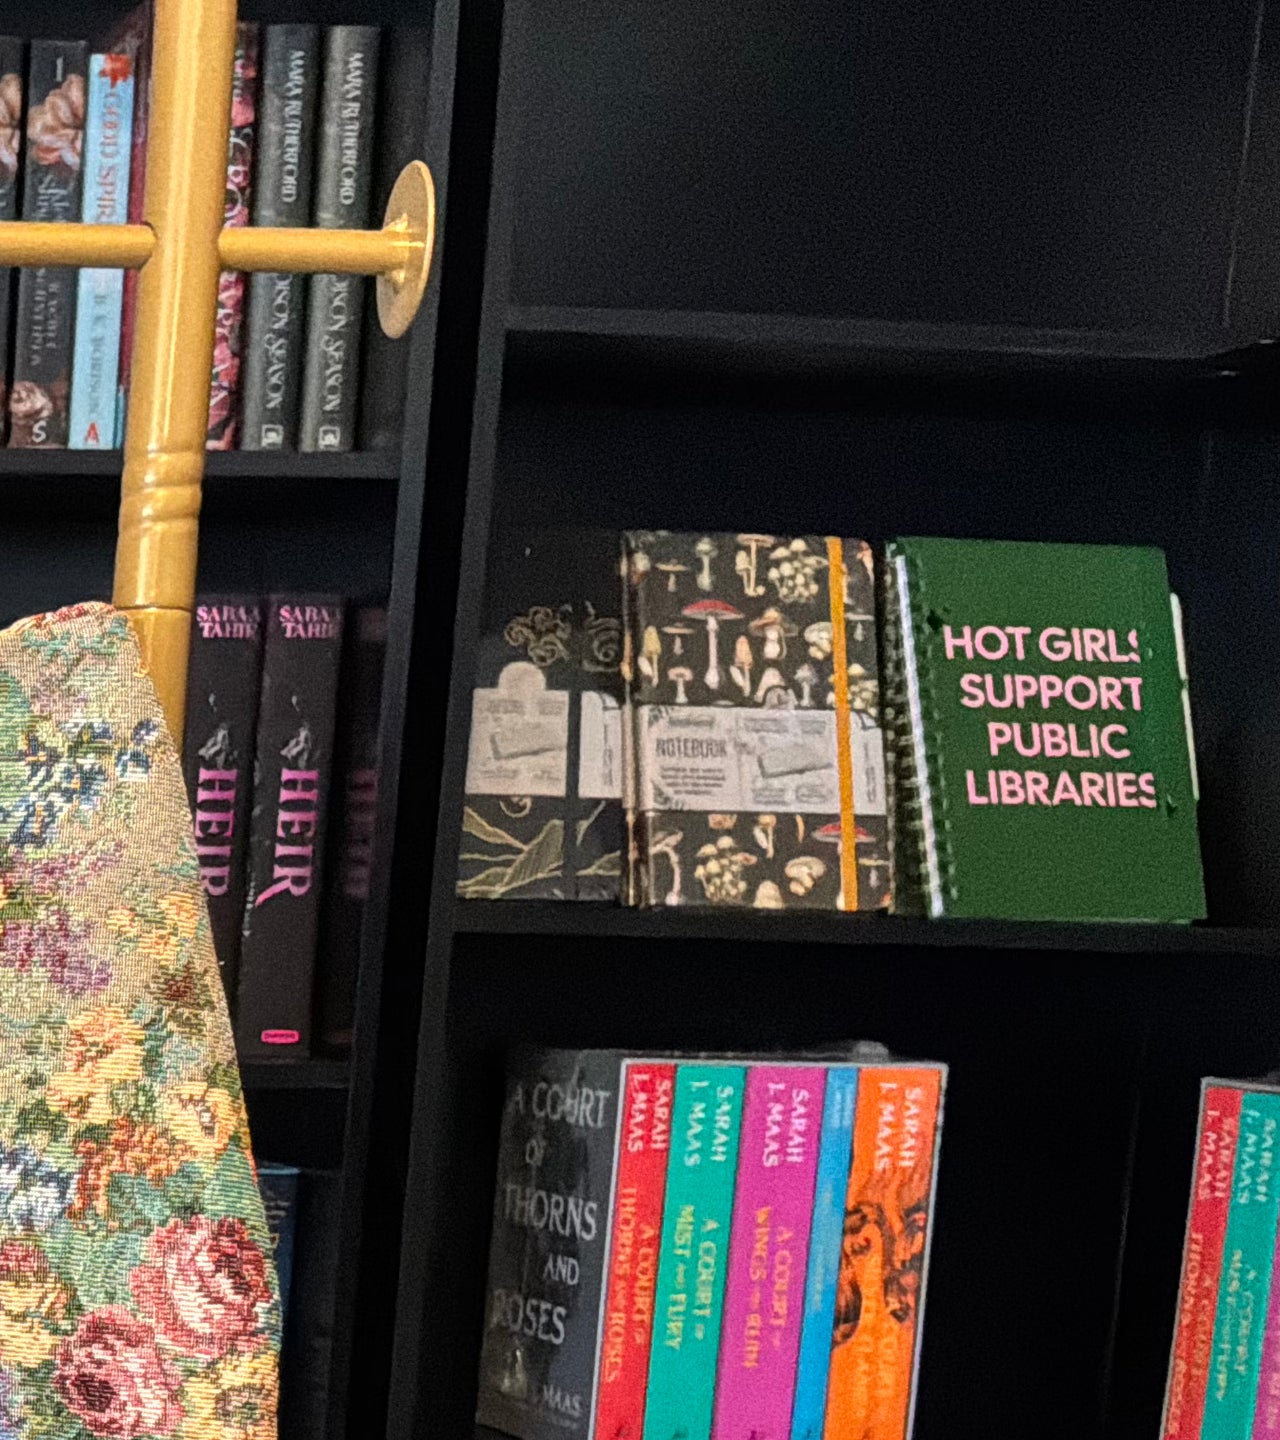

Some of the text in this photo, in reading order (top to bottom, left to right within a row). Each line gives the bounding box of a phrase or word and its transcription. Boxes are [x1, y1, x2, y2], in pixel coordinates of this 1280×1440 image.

[944, 625, 1140, 663] HOT GIRLS
[959, 674, 1142, 710] SUPPORT
[655, 737, 728, 760] NOTEBOOK
[988, 722, 1131, 758] PUBLIC
[966, 770, 1157, 809] LIBRARIES
[255, 767, 319, 908] HEIR
[531, 1081, 611, 1130] COURT
[628, 1091, 649, 1153] MAAS
[651, 1078, 671, 1149] SARAH
[684, 1102, 706, 1167] MAAS
[710, 1085, 734, 1162] SARAH
[762, 1102, 785, 1168] MAAS
[785, 1089, 810, 1163] SARAH
[874, 1101, 895, 1171] MAAS
[898, 1087, 922, 1168] SARAH
[505, 1182, 598, 1242] THORNS
[543, 1254, 580, 1287] AND
